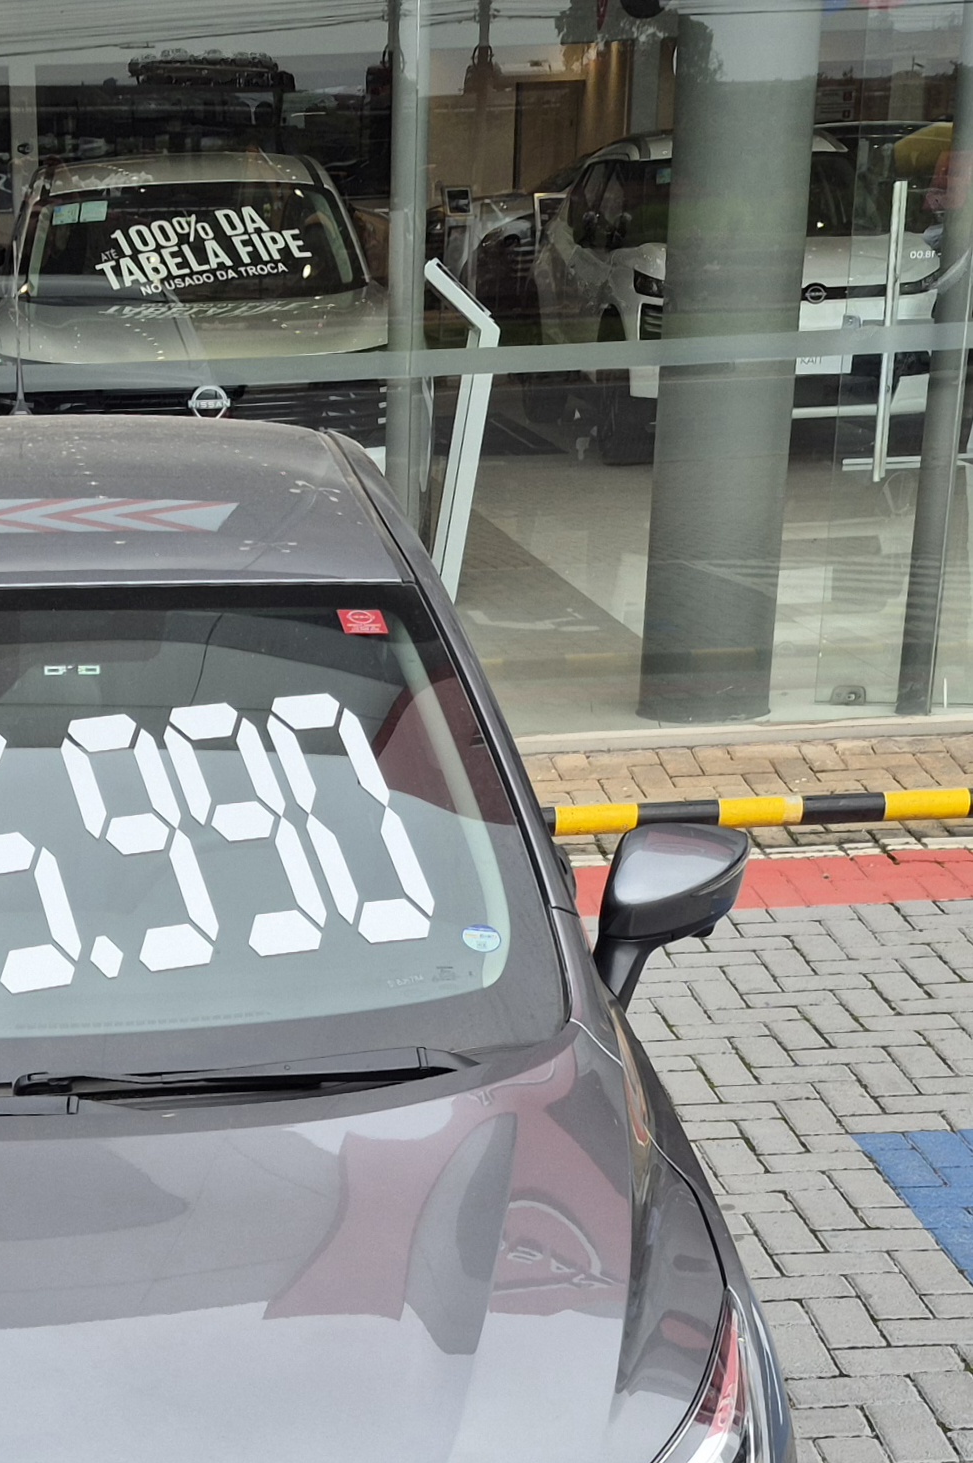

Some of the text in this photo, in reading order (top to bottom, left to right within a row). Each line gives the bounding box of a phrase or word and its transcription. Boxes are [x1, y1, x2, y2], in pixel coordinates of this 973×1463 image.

[110, 214, 214, 256] 100%
[215, 206, 270, 237] DA
[95, 228, 313, 291] TABELA FIPE
[140, 262, 289, 296] NO USADO DA TROCA
[188, 399, 231, 409] NISSAN
